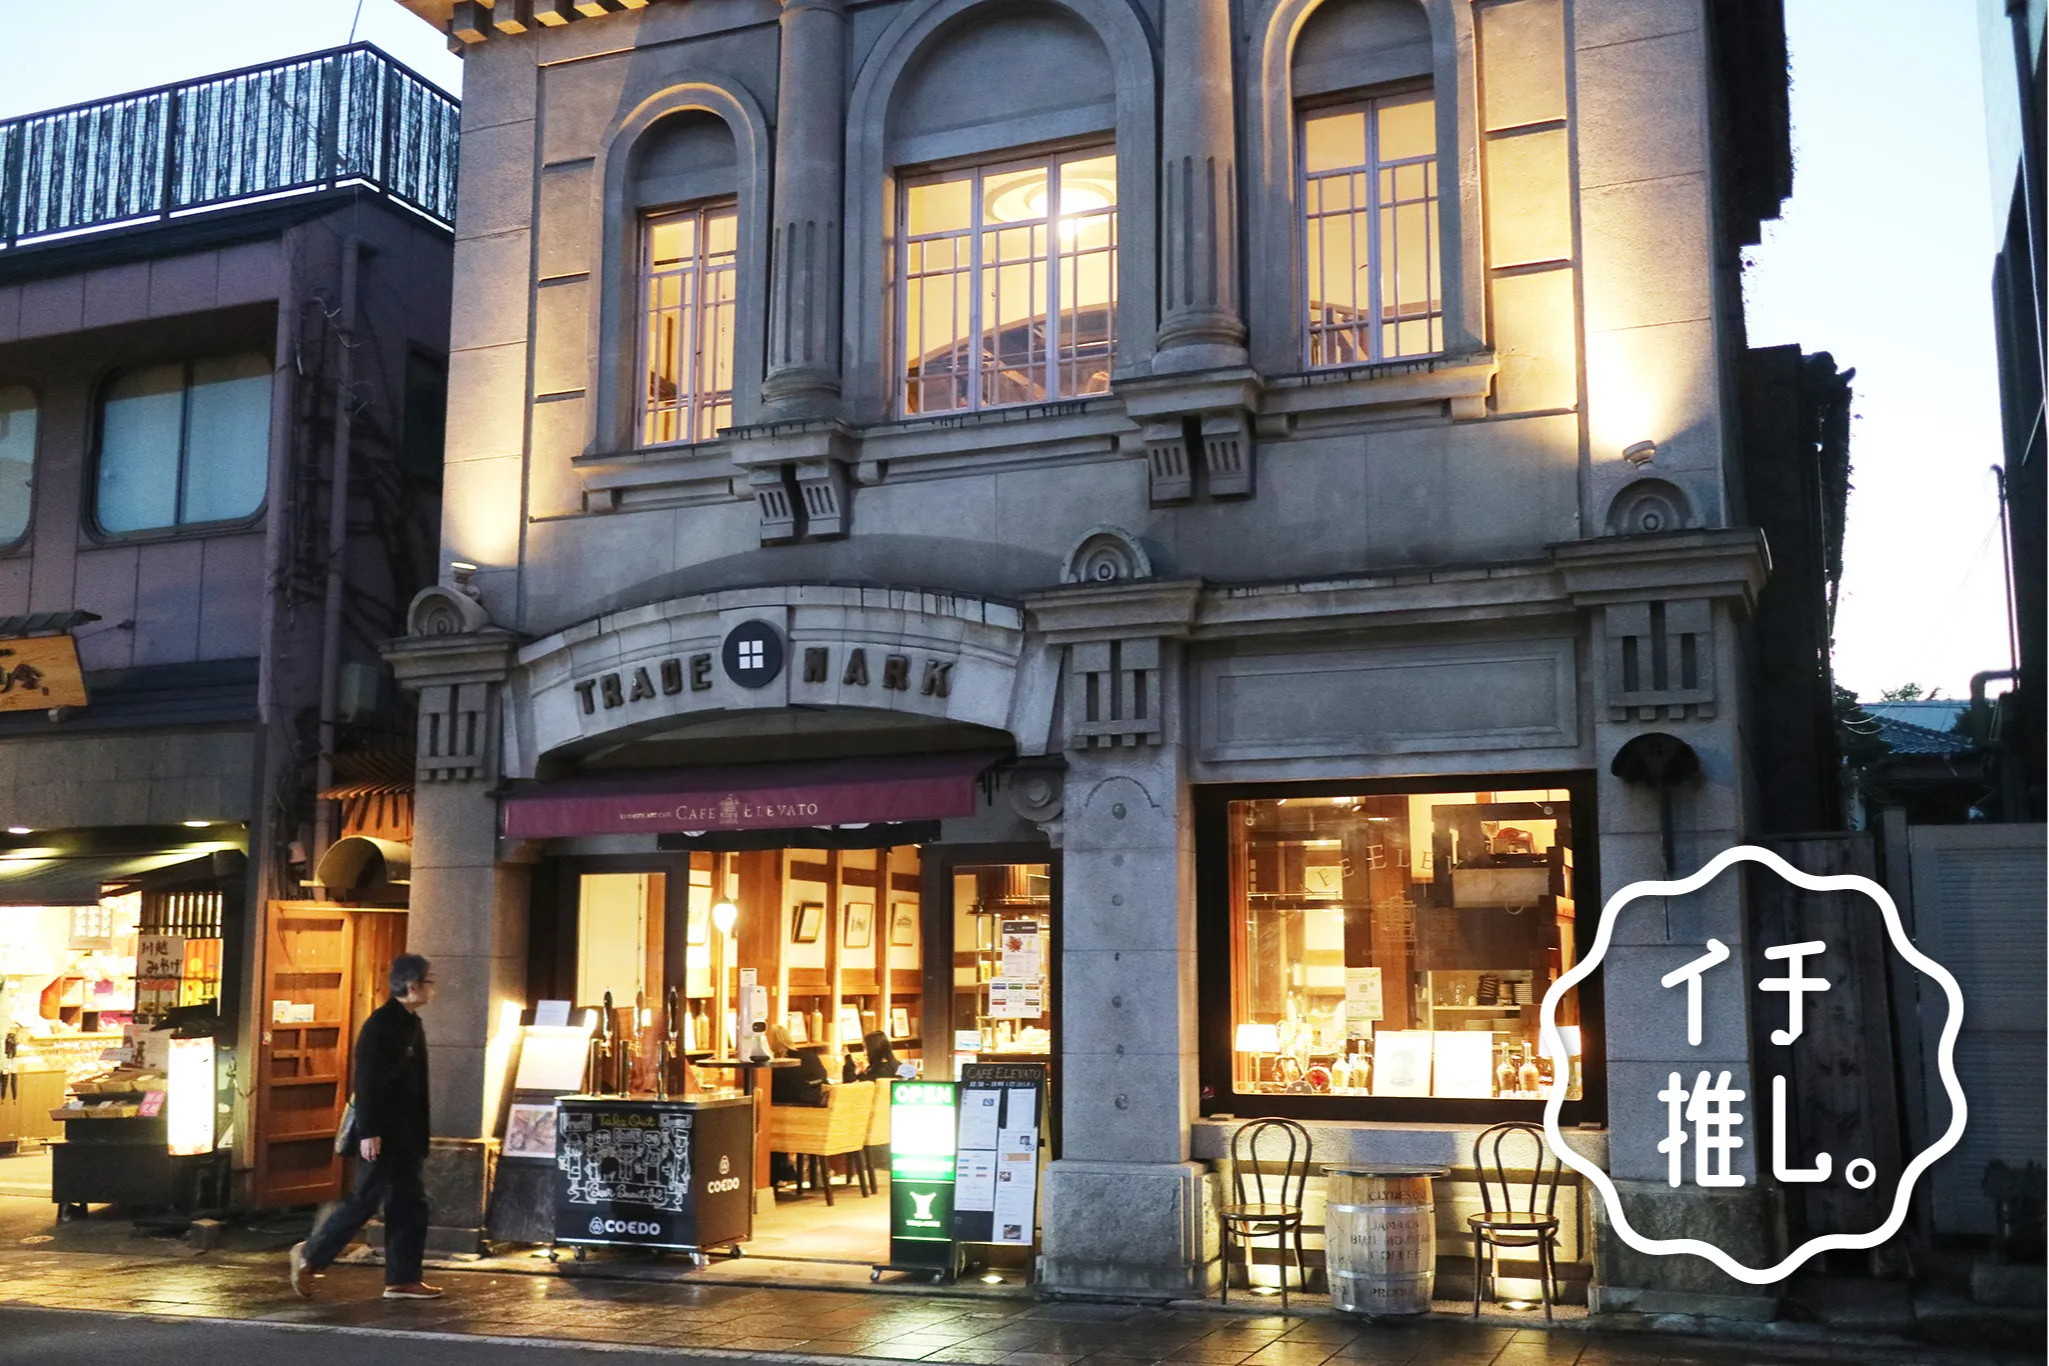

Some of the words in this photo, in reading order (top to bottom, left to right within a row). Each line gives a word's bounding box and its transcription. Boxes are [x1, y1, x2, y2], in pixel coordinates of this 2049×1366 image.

[574, 653, 713, 715] TRADE
[803, 646, 954, 698] MARK
[676, 805, 716, 821] CAFE
[743, 803, 818, 818] ELEVATO
[141, 940, 169, 956] 川越
[146, 958, 182, 974] みやげ
[995, 1067, 1041, 1079] ELEVATO
[895, 1085, 952, 1103] OPEN
[597, 1112, 628, 1127] Take
[628, 1113, 656, 1127] Out
[707, 1177, 740, 1194] COEDO
[604, 1219, 661, 1235] COEDO
